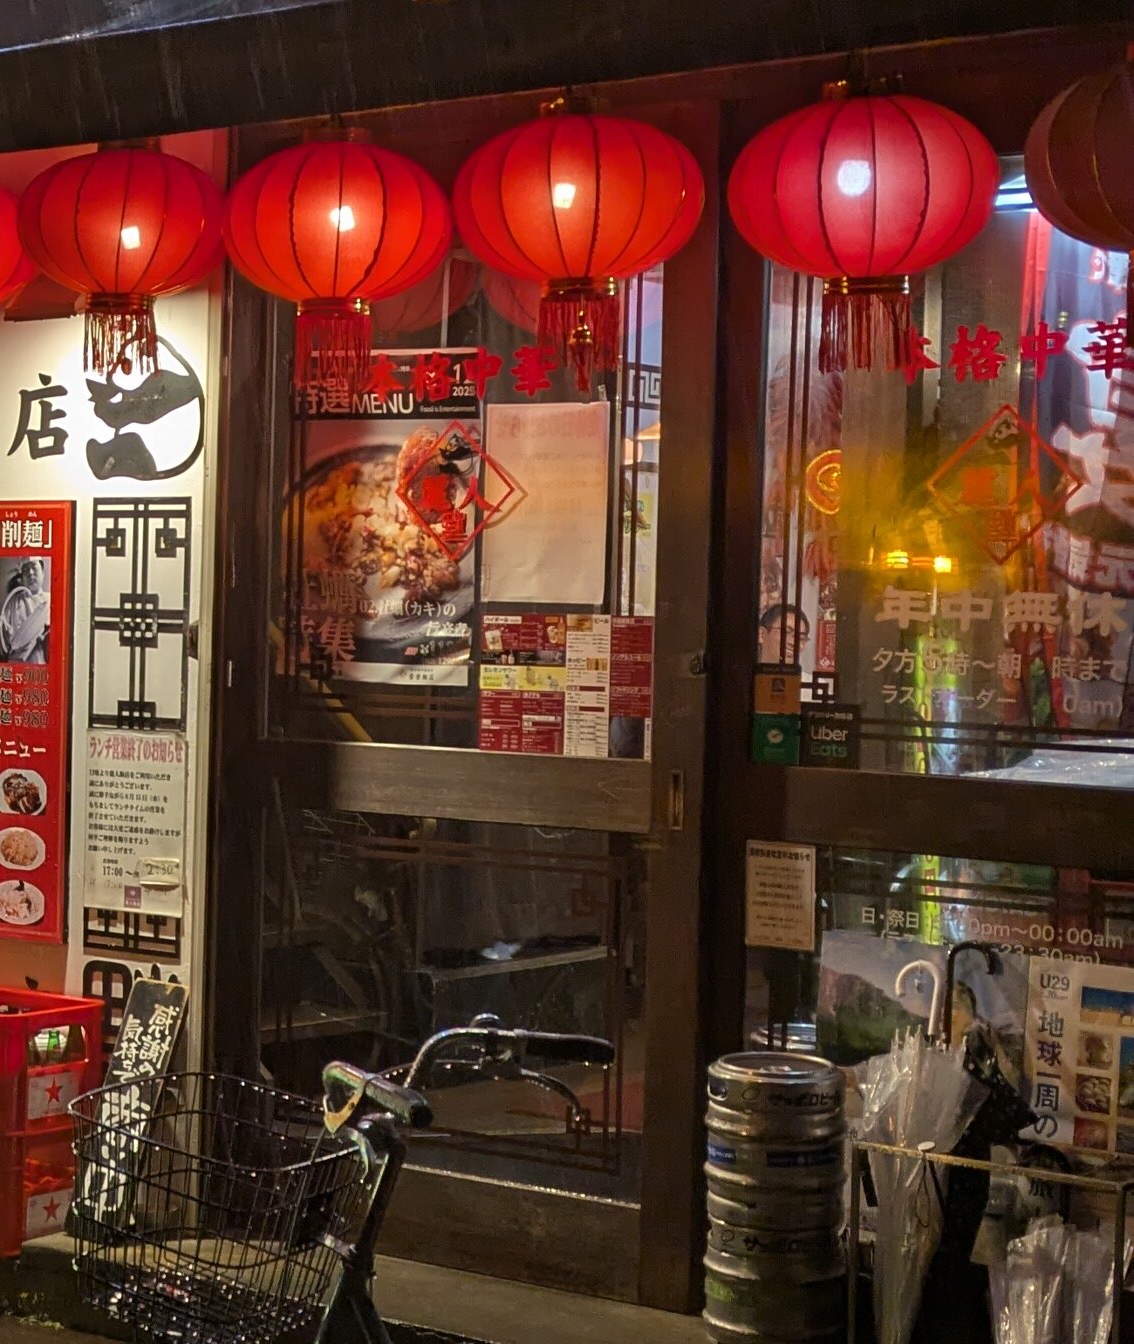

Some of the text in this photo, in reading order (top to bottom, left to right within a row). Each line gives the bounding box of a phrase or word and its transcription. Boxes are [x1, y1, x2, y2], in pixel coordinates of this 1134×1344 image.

[362, 345, 559, 402] 本格中華
[874, 584, 1128, 638] 年中無休
[1040, 973, 1070, 990] U29
